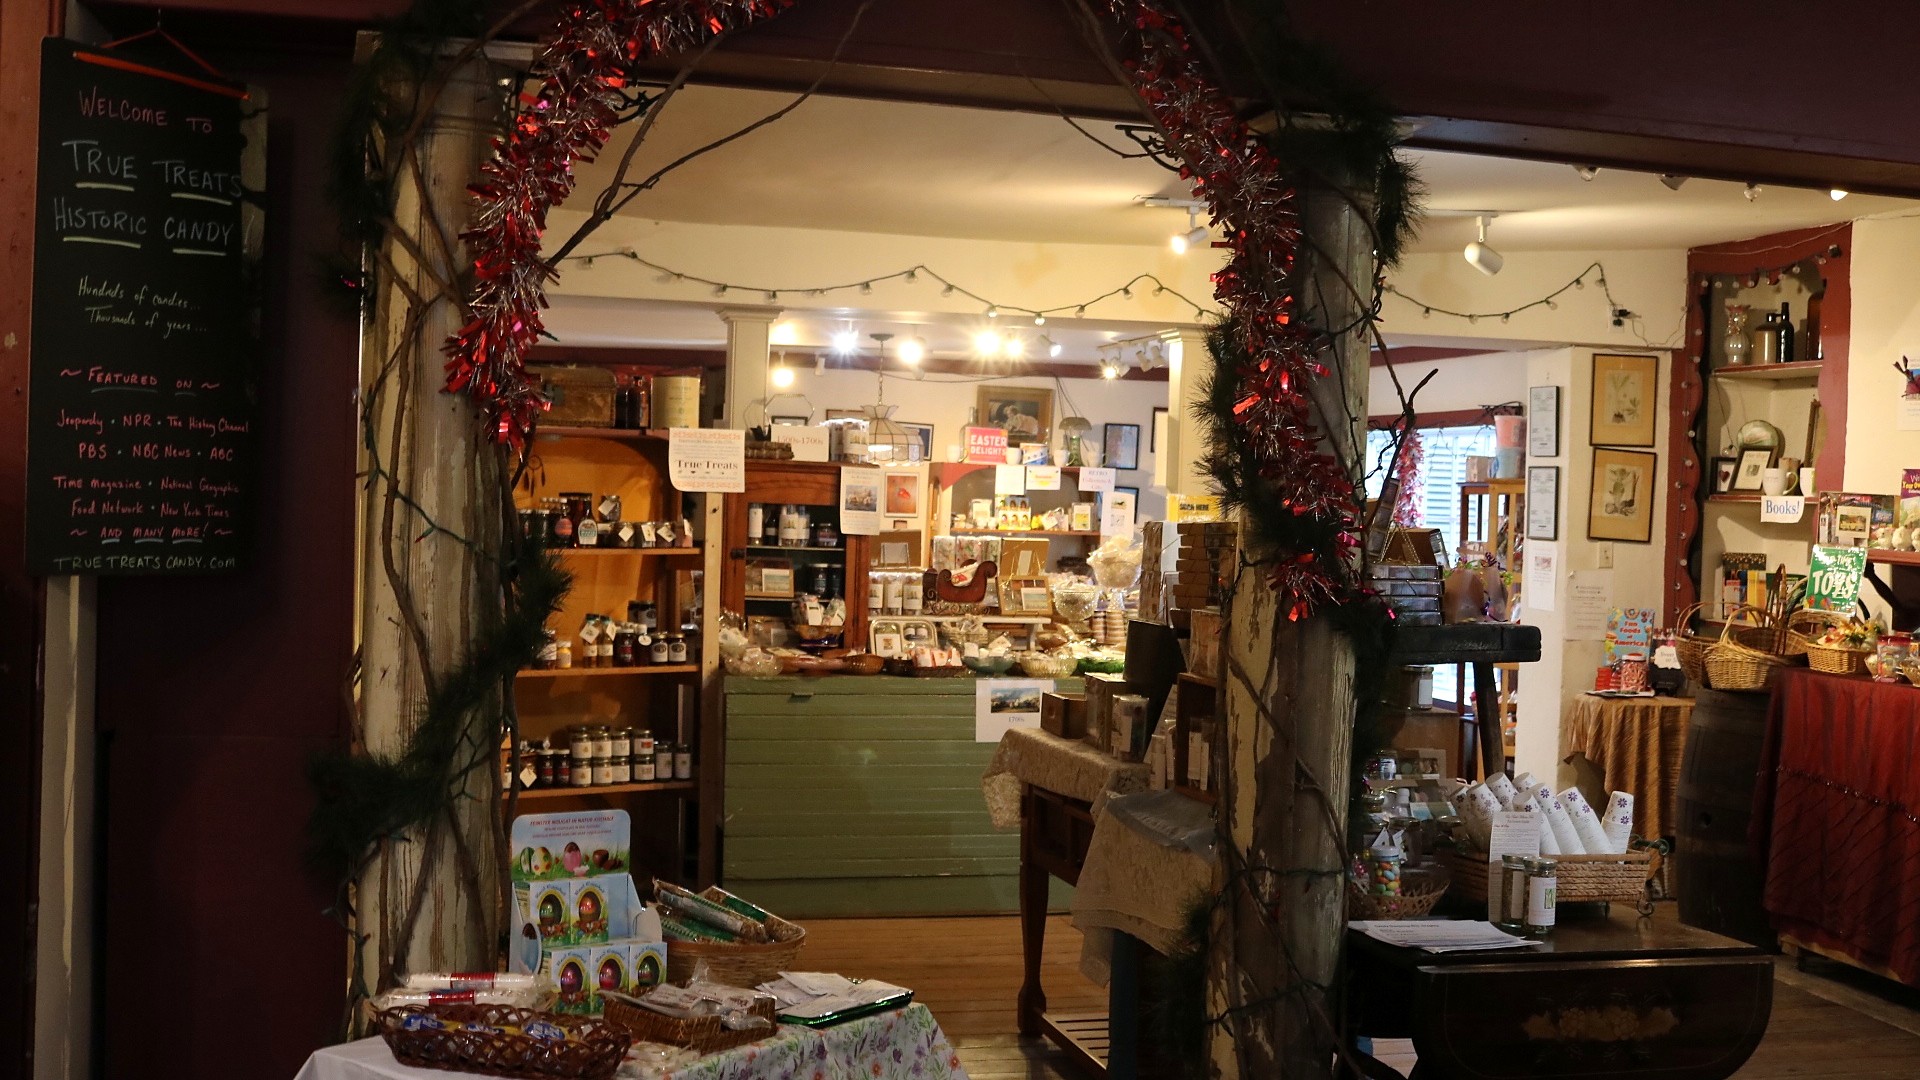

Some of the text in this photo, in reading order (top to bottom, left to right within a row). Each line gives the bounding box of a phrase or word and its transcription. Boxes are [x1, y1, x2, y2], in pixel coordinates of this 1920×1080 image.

[62, 139, 243, 198] TRUE TREATS
[54, 196, 234, 246] HISTORIC CANDY
[78, 275, 124, 299] Hundreds
[134, 284, 148, 305] of
[84, 304, 136, 325] Thousands
[145, 312, 158, 328] of
[88, 365, 158, 386] FEATURED
[56, 408, 249, 438] Jeopardy NPR The History Channel
[970, 434, 1007, 446] EASTER
[79, 443, 233, 462] PBS NBC News ABC
[970, 446, 1007, 456] DELIGHTS
[676, 459, 738, 469] True Treats
[160, 476, 193, 491] National
[199, 477, 240, 497] Geographic
[71, 497, 230, 518] Food Network New York Times
[1766, 499, 1800, 515] Books!
[101, 527, 123, 539] AND
[133, 525, 164, 538] MANY
[1812, 570, 1857, 599] TOYS
